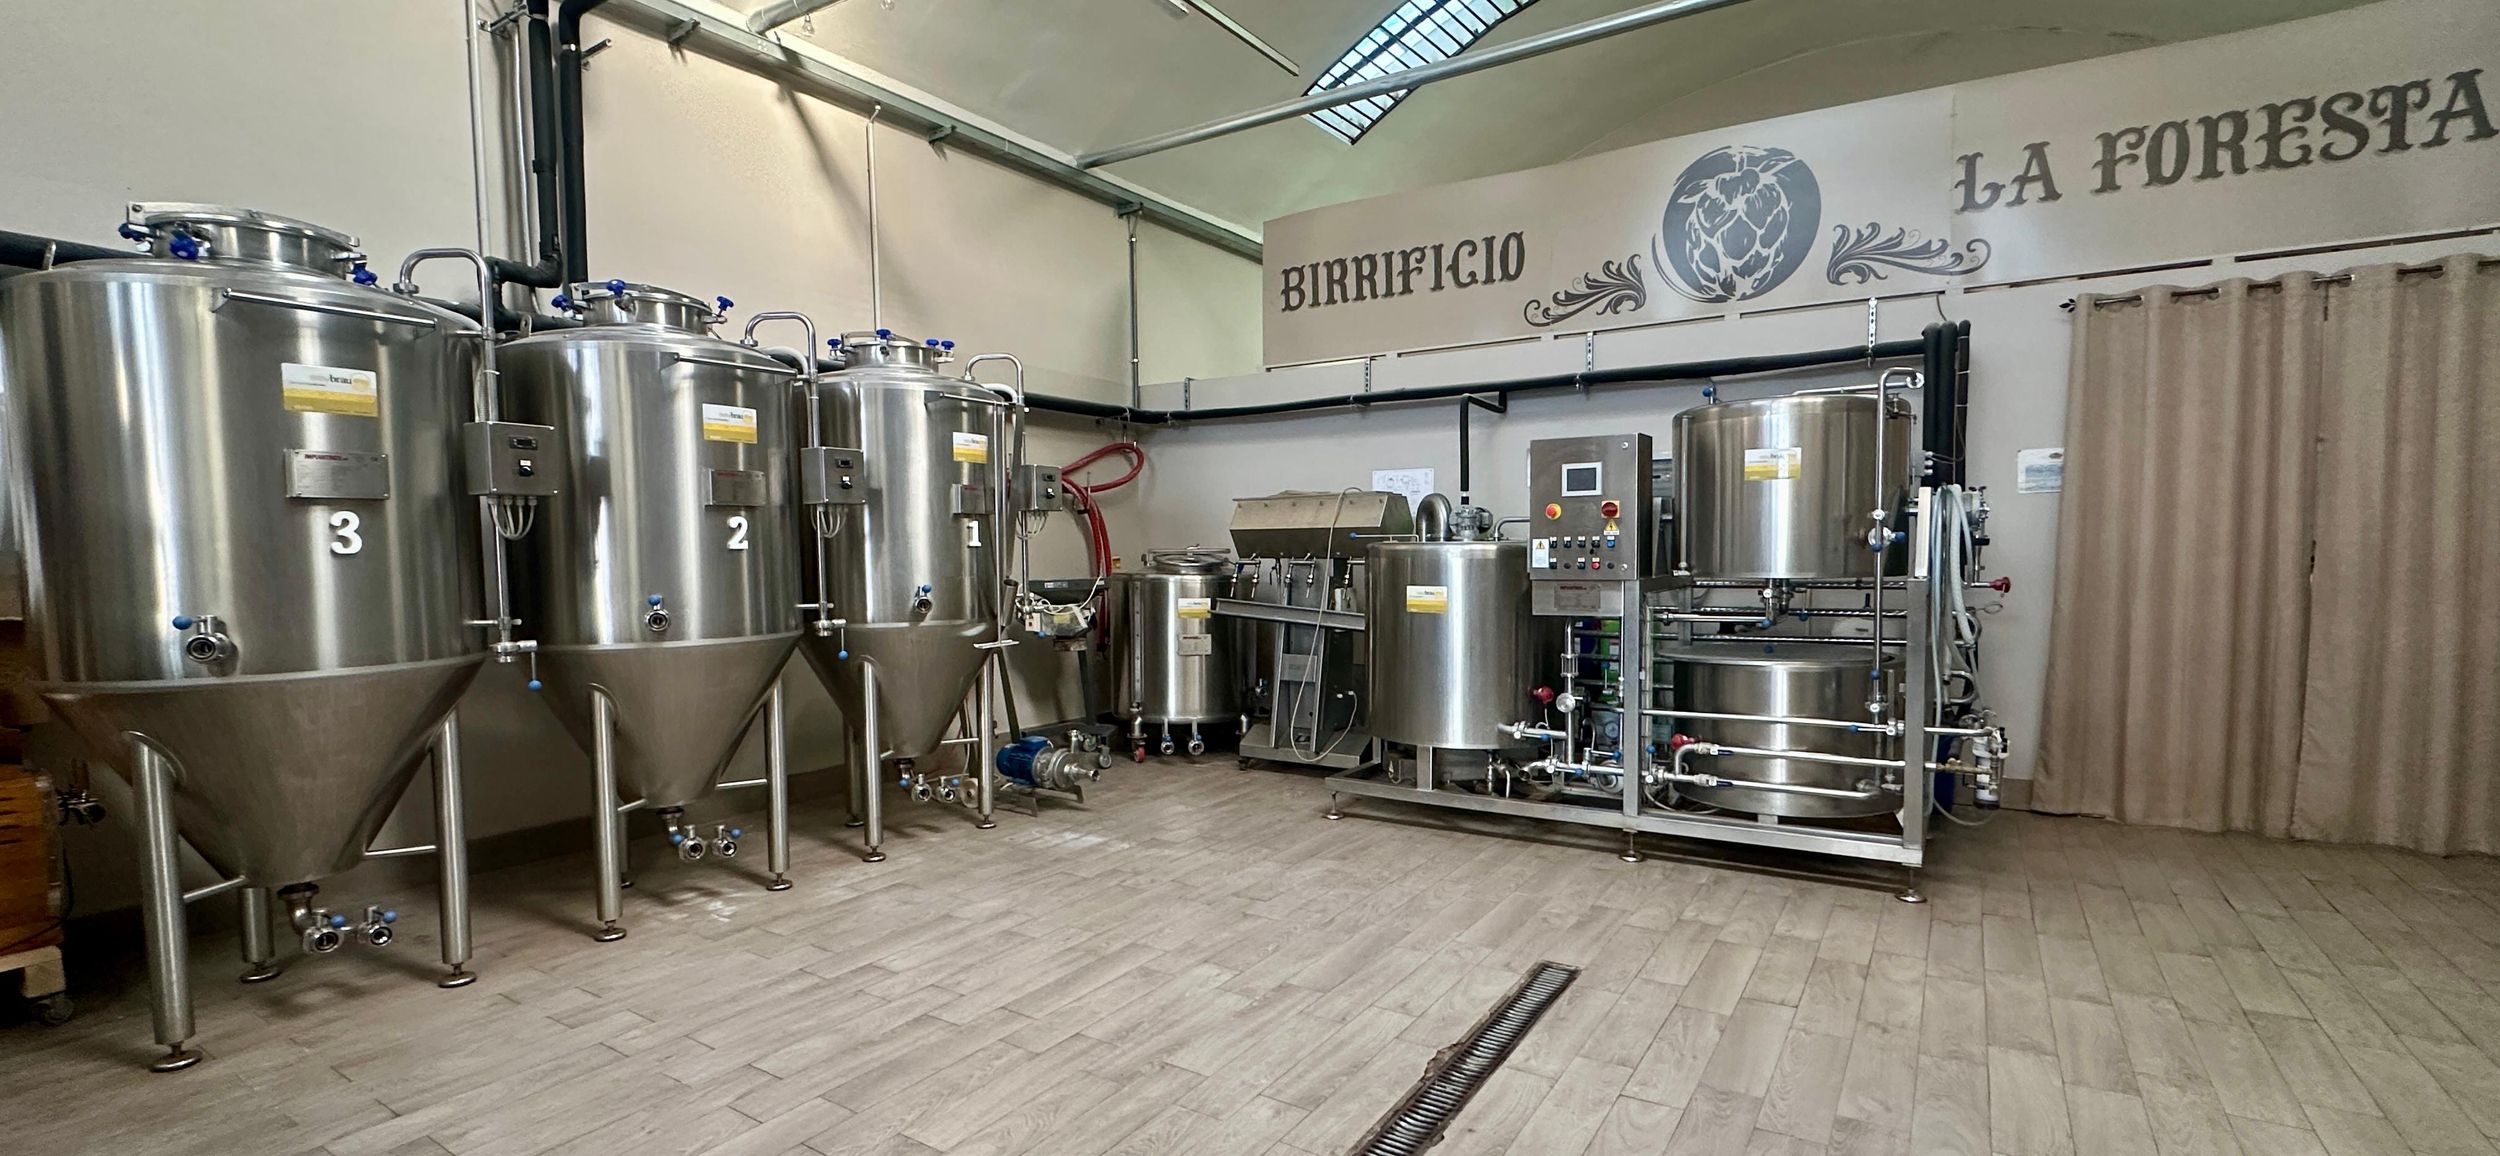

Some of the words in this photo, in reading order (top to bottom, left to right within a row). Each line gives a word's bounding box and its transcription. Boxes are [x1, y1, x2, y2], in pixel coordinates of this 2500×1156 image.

[1280, 231, 1526, 313] BIRRIFICIO
[1954, 141, 2063, 214] LA
[2090, 68, 2500, 195] FORESTA
[330, 510, 363, 555] 3
[727, 516, 749, 550] 2
[967, 520, 982, 547] 1
